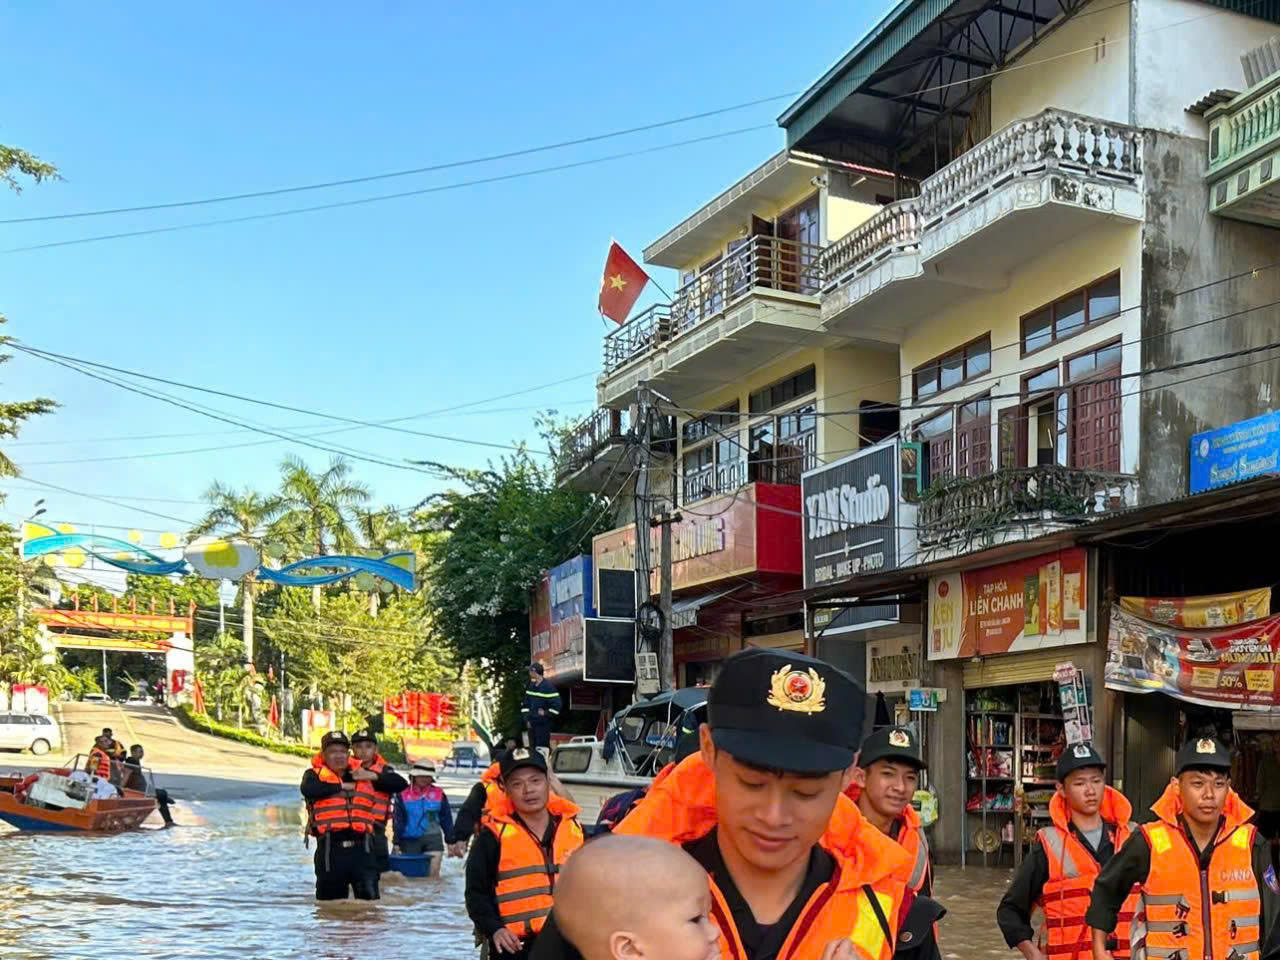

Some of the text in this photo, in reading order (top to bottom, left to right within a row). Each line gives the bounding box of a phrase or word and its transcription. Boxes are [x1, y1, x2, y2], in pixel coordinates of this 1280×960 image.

[970, 592, 1024, 617] LIÊN CHANH
[1219, 674, 1243, 689] 50%
